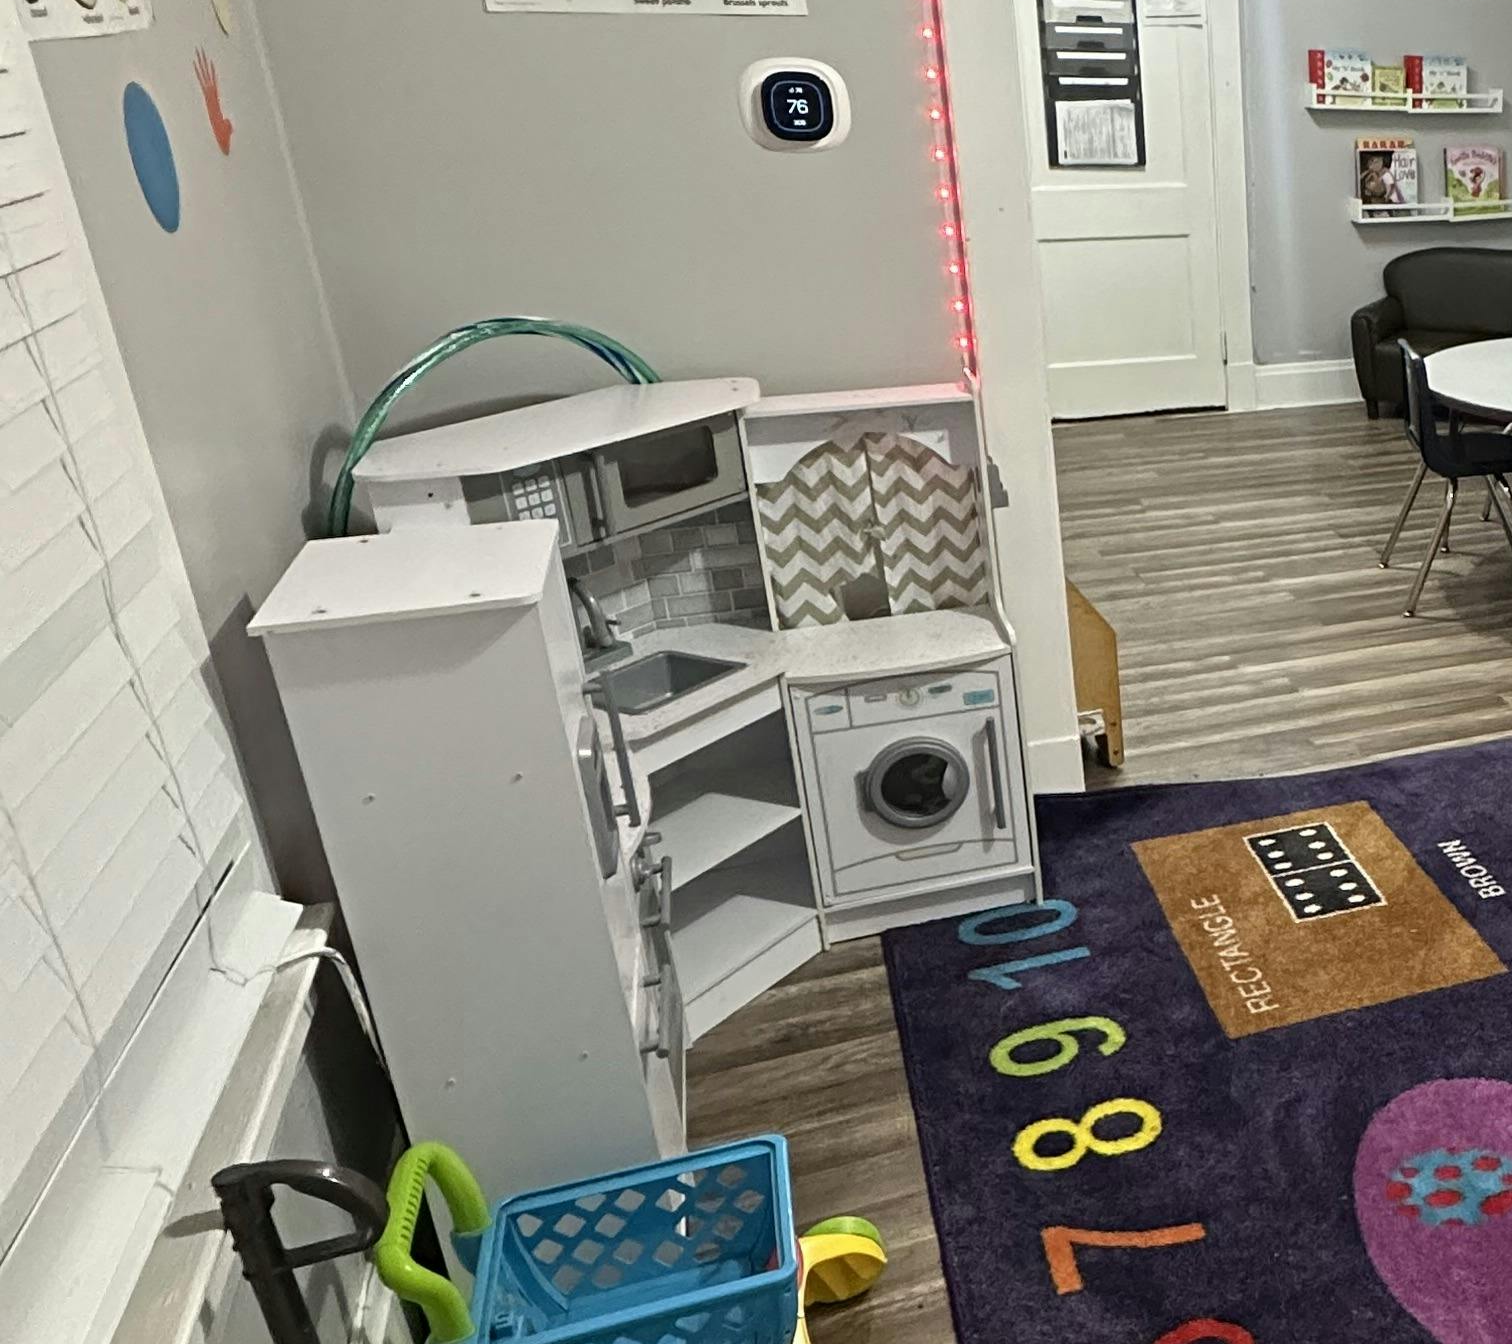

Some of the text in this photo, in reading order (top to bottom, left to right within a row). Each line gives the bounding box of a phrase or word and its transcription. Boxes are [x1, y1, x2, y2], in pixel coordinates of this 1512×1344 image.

[787, 99, 809, 114] 76
[1393, 152, 1415, 167] Hair
[1438, 838, 1507, 899] BROWN
[958, 898, 1092, 991] 10
[1191, 893, 1280, 1015] RECTANGLE
[989, 1015, 1127, 1077] 9
[1013, 1097, 1163, 1171] 8
[1042, 1221, 1206, 1295] 7
